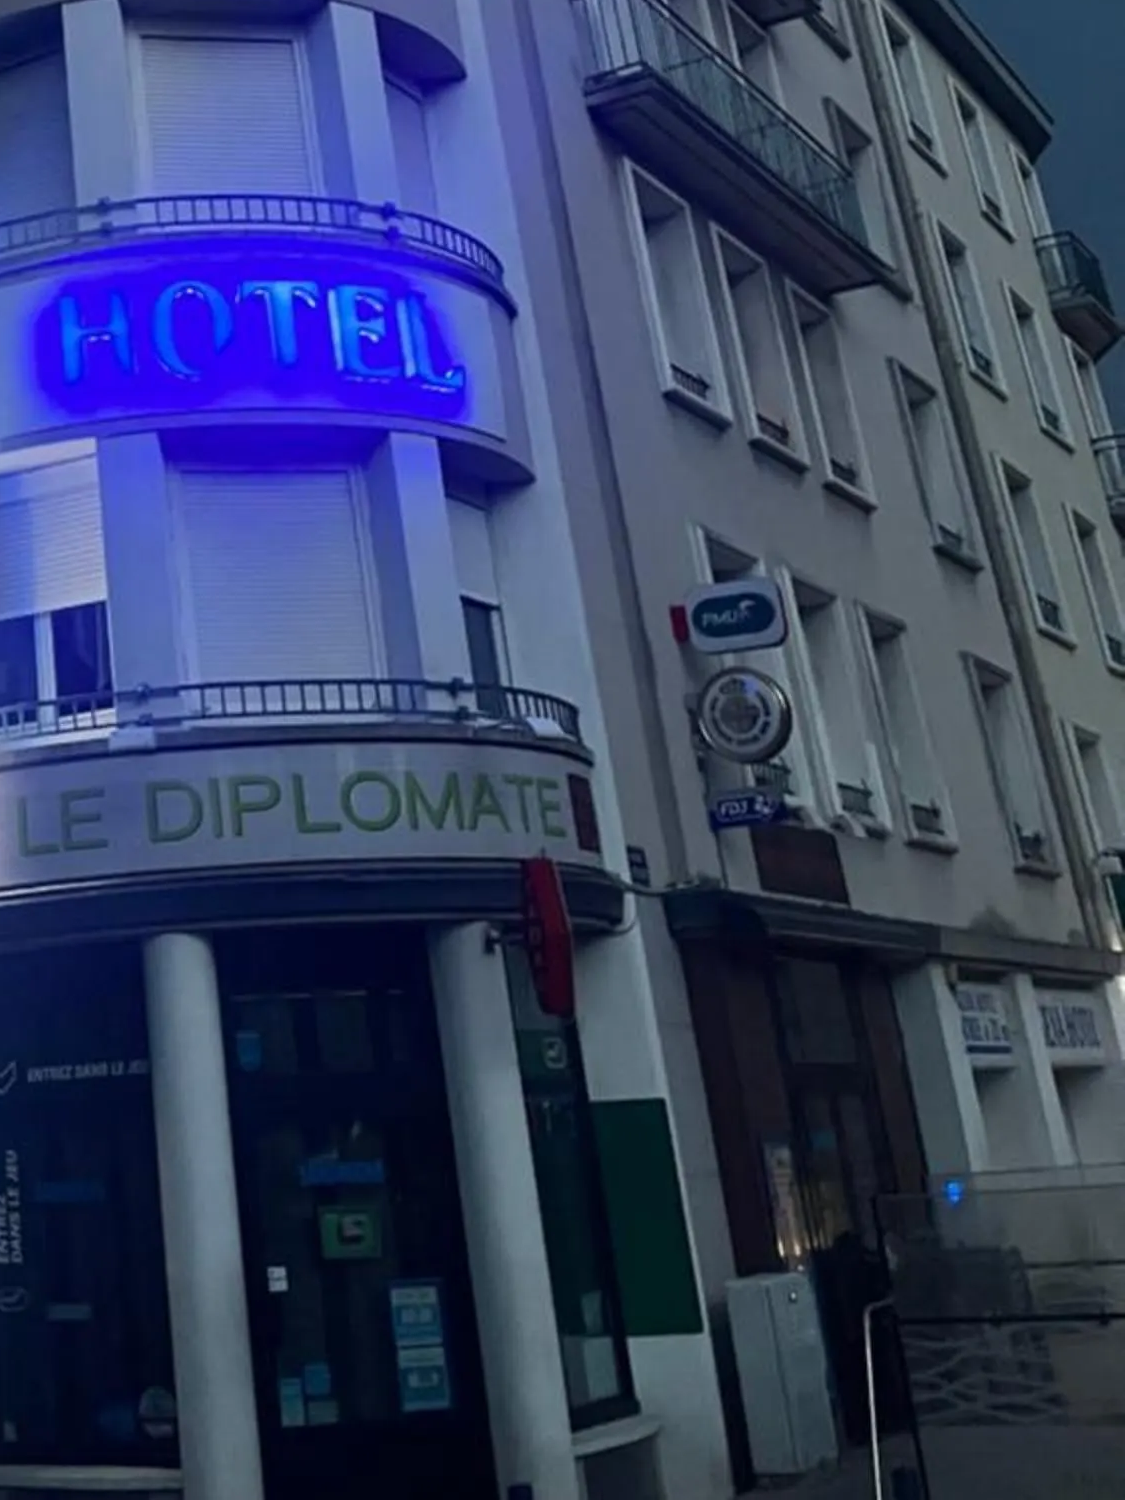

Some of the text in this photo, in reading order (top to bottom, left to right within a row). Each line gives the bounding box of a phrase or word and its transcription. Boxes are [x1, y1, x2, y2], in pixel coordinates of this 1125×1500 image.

[57, 278, 466, 392] HOTEL
[15, 771, 568, 857] LE DIPLOMATE
[5, 1150, 23, 1264] DANS LE JEU
